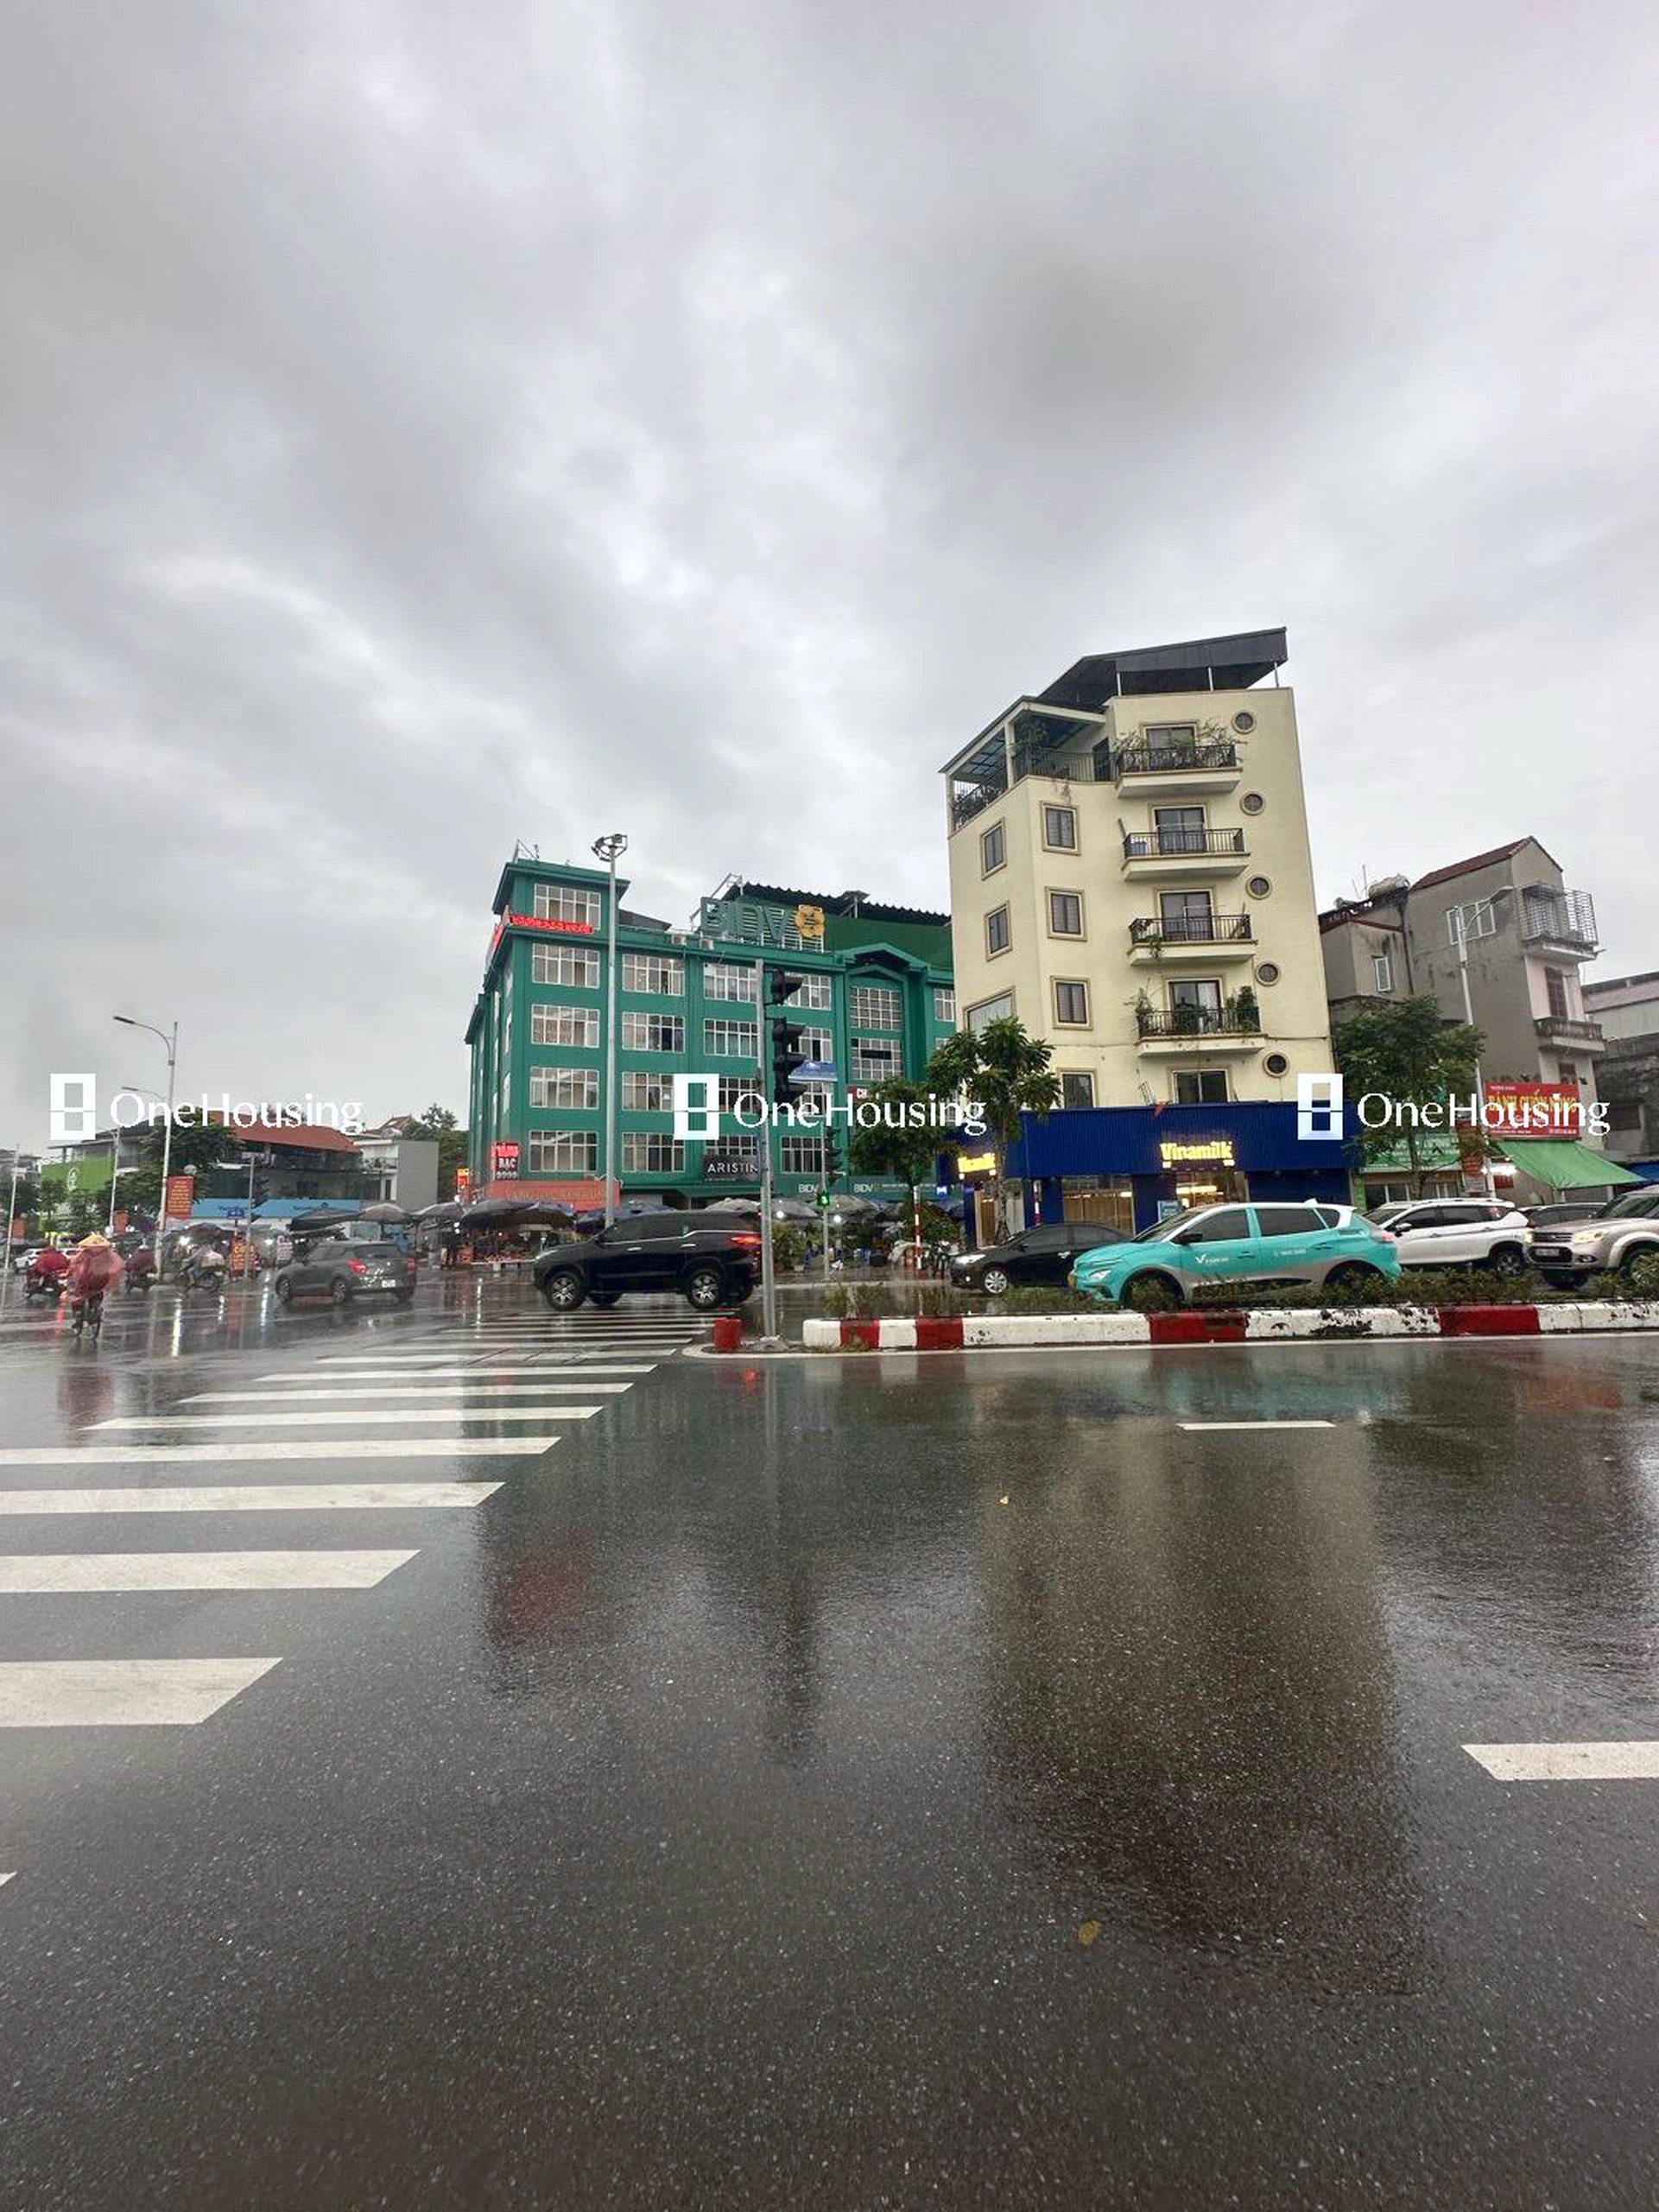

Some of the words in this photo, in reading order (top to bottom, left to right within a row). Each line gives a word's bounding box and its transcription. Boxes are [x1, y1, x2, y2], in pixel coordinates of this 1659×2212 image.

[700, 897, 796, 941] BIDV
[1160, 1141, 1233, 1160] Vinamilk
[706, 1162, 760, 1173] ARISTIN
[798, 1184, 819, 1193] BIDV
[853, 1184, 874, 1193] BIDV
